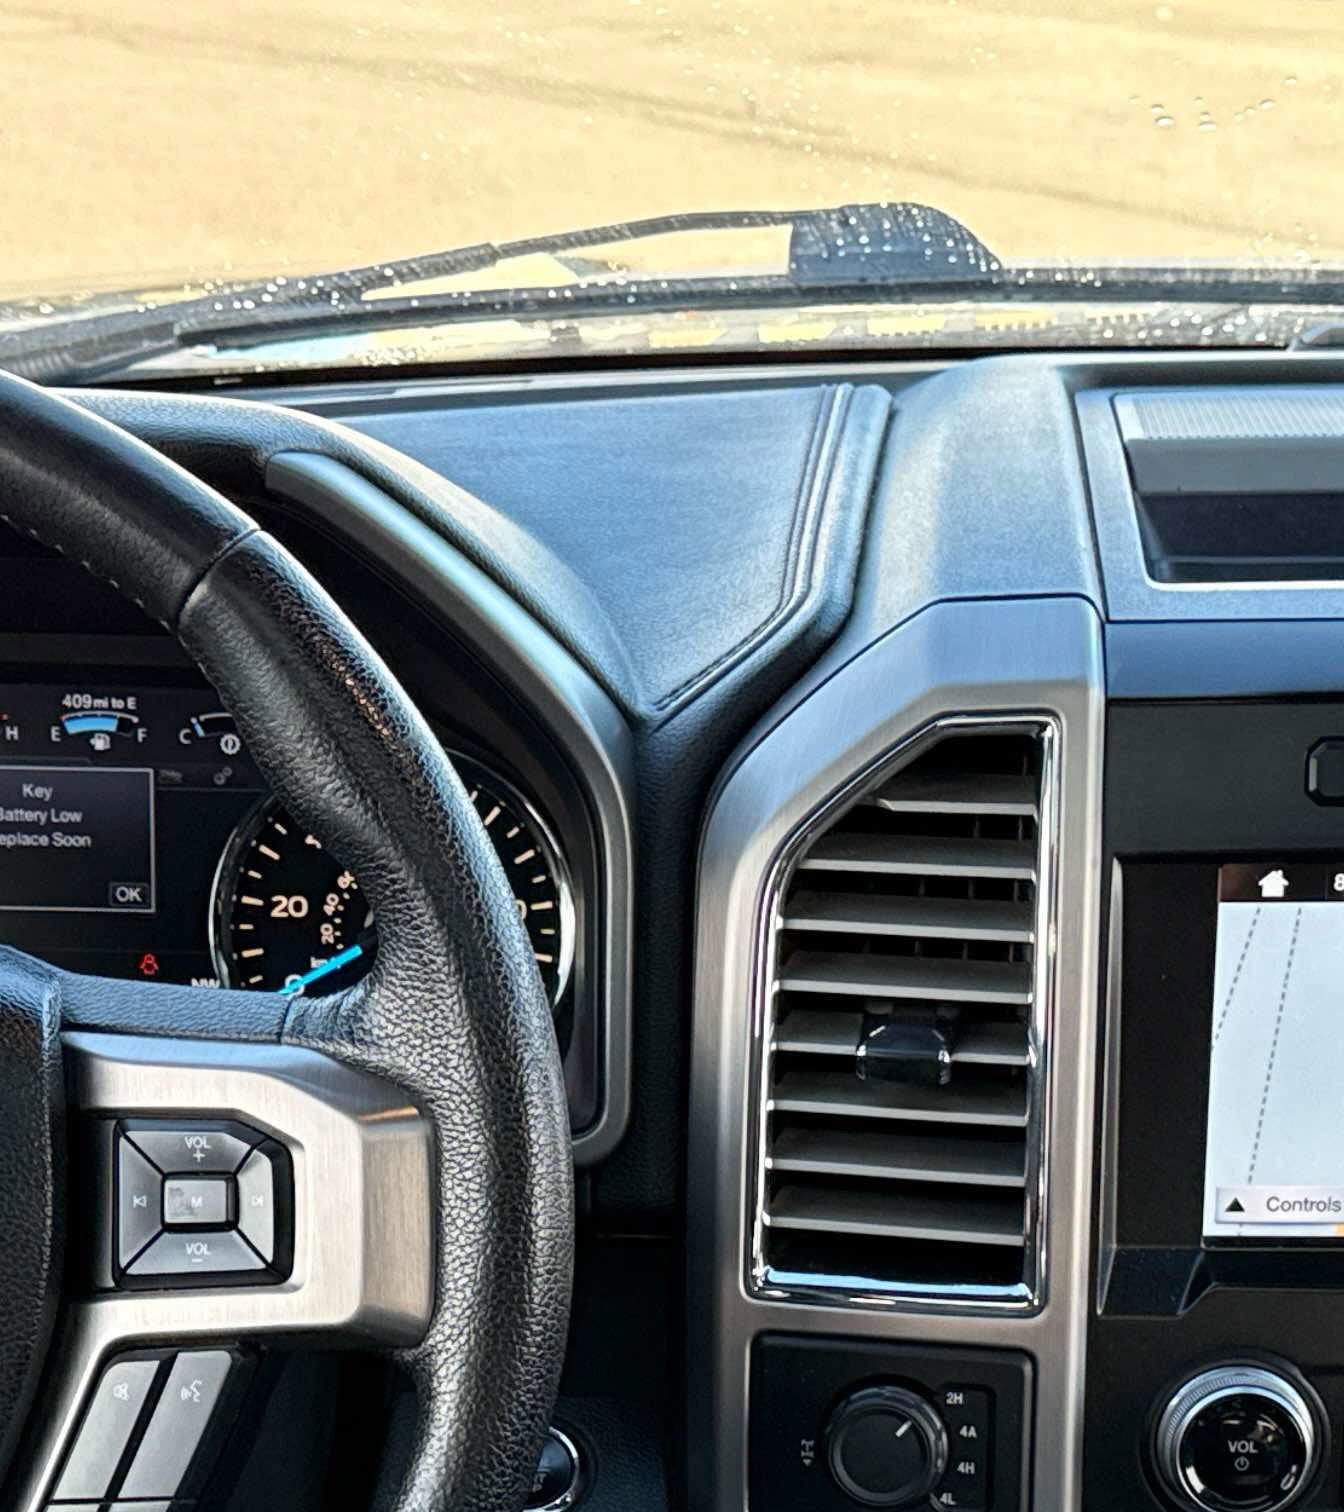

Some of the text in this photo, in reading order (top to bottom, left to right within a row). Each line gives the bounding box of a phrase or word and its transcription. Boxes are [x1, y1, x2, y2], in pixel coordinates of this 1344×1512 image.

[110, 696, 125, 710] to
[126, 696, 137, 710] E
[5, 726, 19, 741] H
[51, 727, 61, 742] E
[137, 728, 147, 743] F
[179, 728, 192, 744] C
[22, 783, 53, 802] Key
[51, 807, 83, 823] Low
[51, 832, 92, 847] Soon
[115, 887, 142, 902] OK
[269, 894, 310, 919] 20
[323, 892, 340, 916] 40
[319, 922, 335, 945] 20
[184, 1135, 211, 1149] VOL
[191, 1195, 203, 1207] M
[1265, 1195, 1343, 1213] Controls
[185, 1242, 211, 1256] VOL
[946, 1392, 965, 1405] 2H
[959, 1426, 978, 1439] 4A
[1227, 1440, 1258, 1454] VOL
[957, 1462, 976, 1475] 4H
[940, 1493, 956, 1506] 4L
